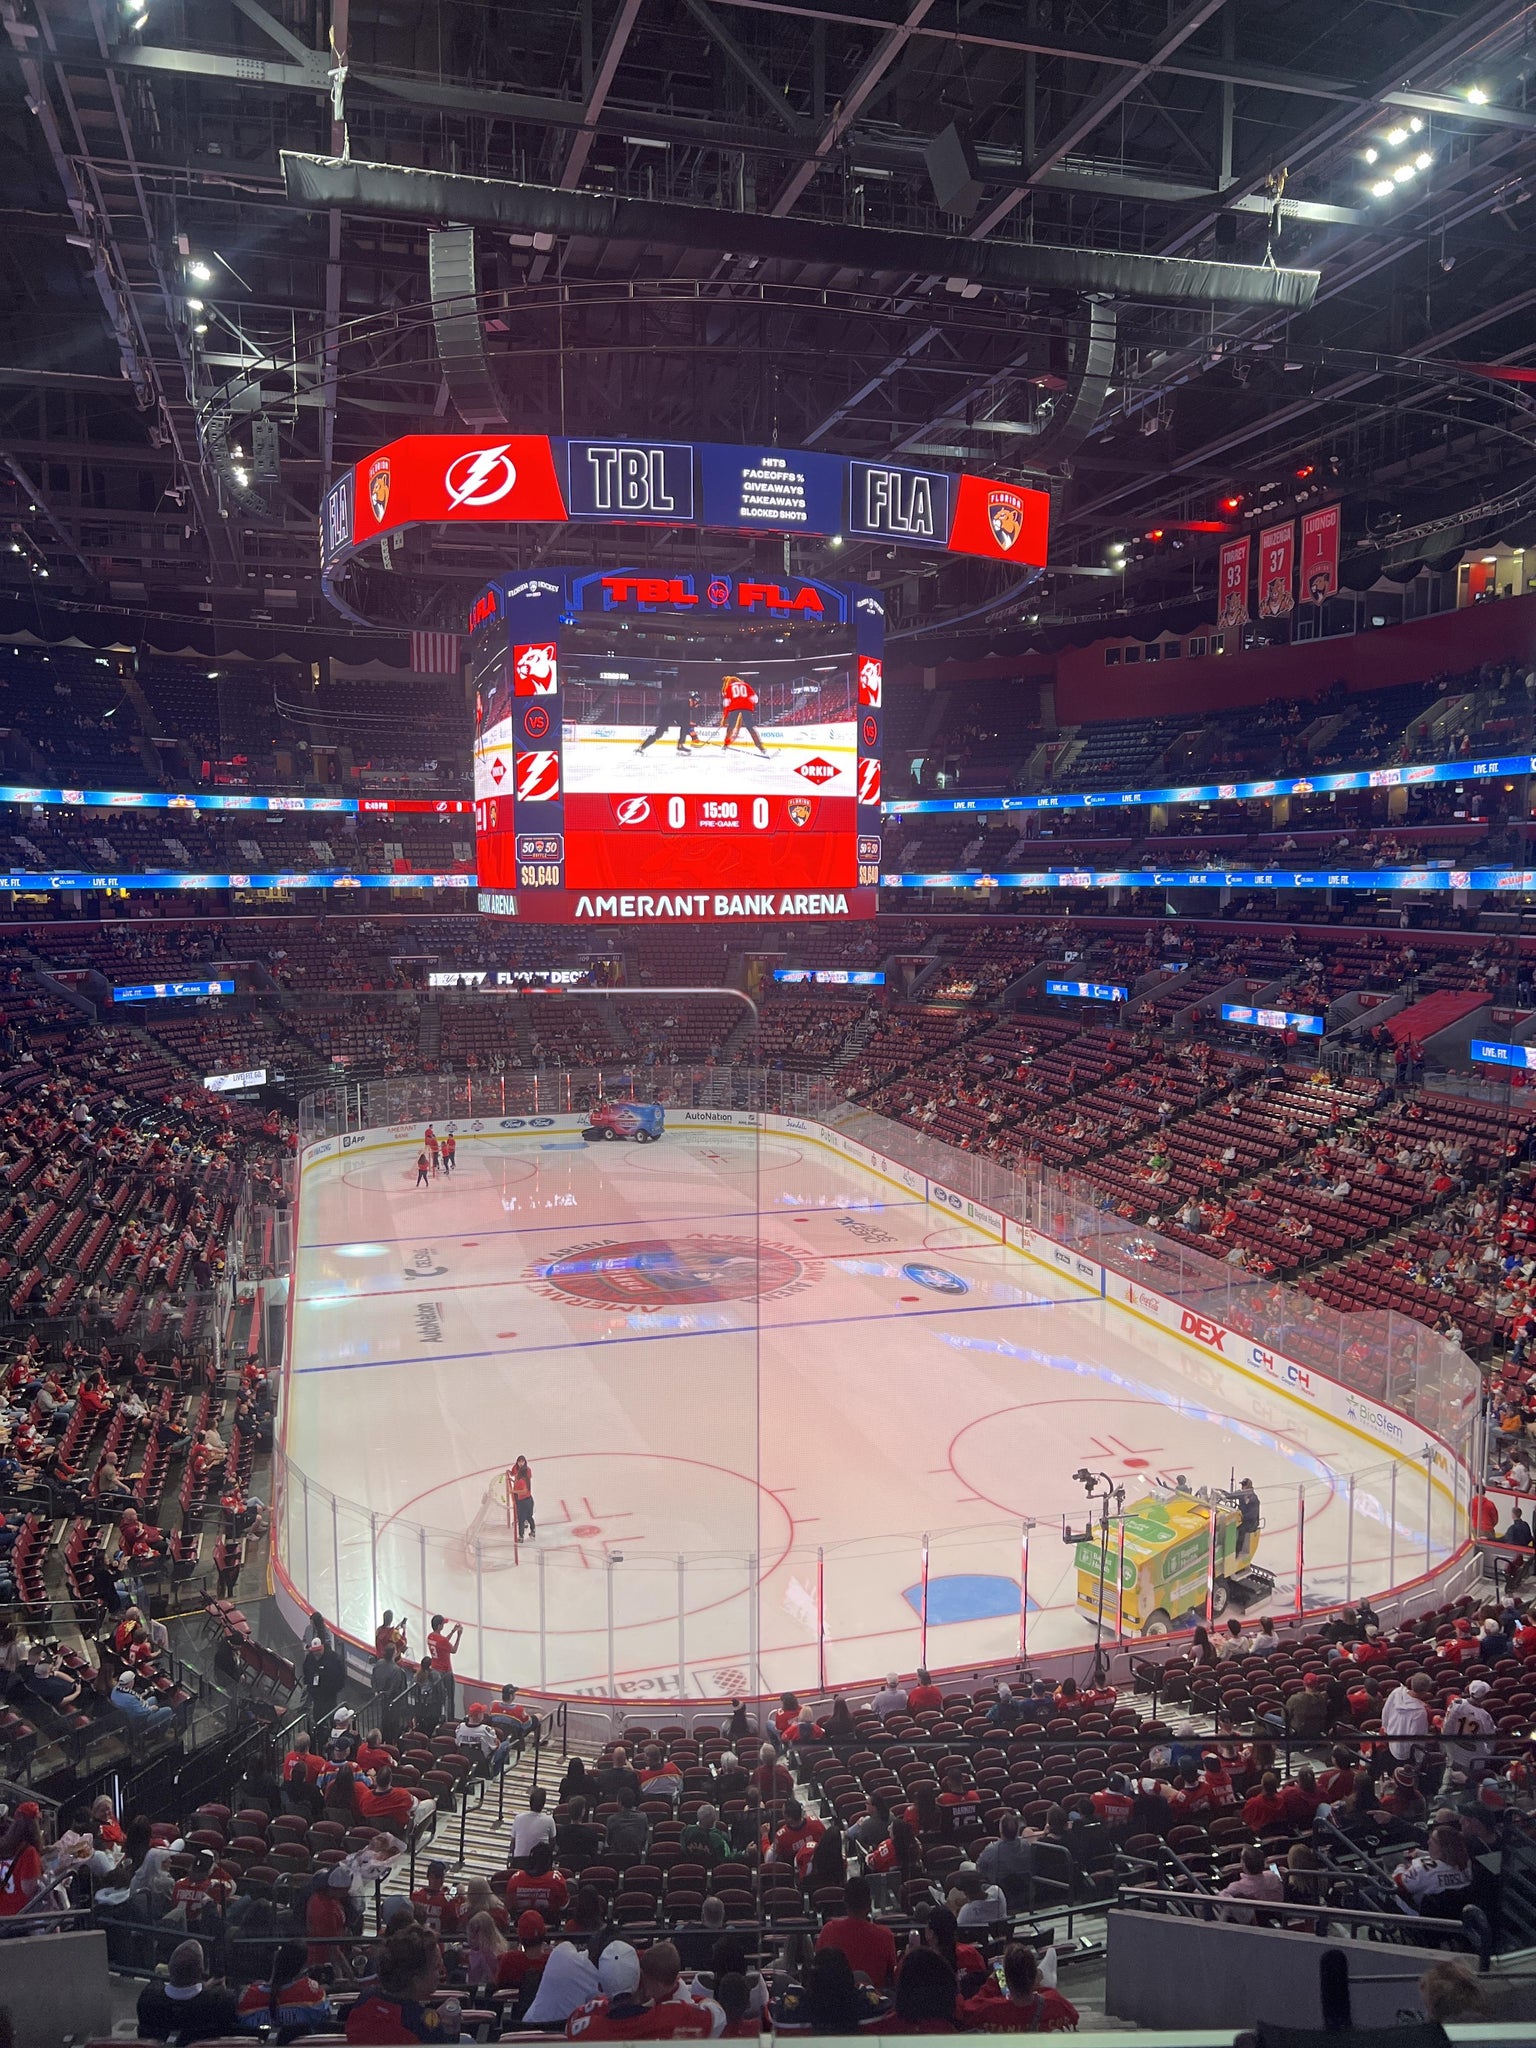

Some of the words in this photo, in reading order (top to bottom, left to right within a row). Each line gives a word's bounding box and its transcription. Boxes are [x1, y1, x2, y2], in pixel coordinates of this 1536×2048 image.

[762, 457, 786, 468] HITS
[588, 448, 674, 510] TBL
[743, 469, 796, 482] FACEOFFS
[796, 474, 805, 482] %
[744, 482, 804, 495] GIVEAWAYS
[742, 494, 806, 508] TAKEAWAYS
[867, 469, 934, 534] FLA
[990, 493, 1021, 508] FLORIDA
[329, 484, 348, 550] FLA
[740, 507, 778, 519] BLOCKED
[779, 509, 807, 521] SHOTS
[1305, 512, 1337, 535] LUONGO
[1223, 548, 1246, 564] TORREY
[1316, 534, 1324, 556] 1
[1269, 549, 1285, 572] 37
[1226, 564, 1241, 588] 93
[602, 578, 699, 604] TBL
[739, 583, 825, 611] FLA
[529, 717, 544, 728] VS
[800, 766, 834, 777] ORKIN
[668, 796, 686, 829] 0
[702, 802, 738, 818] 15:00
[753, 797, 769, 829] 0
[522, 842, 535, 853] 50
[545, 842, 557, 853] 50
[521, 865, 559, 887] $9,640
[492, 894, 515, 916] ARENA
[575, 894, 710, 917] AMERANT
[715, 894, 775, 916] BANK
[779, 893, 849, 915] ARENA
[497, 971, 549, 985] FLIGT
[685, 1112, 732, 1121] AutoNation
[351, 1136, 365, 1144] App
[387, 1125, 416, 1133] AMERANT
[552, 1238, 619, 1259] ARENA
[414, 1302, 443, 1343] AutoNation
[1180, 1310, 1227, 1352] DEX
[1252, 1348, 1273, 1370] CH
[1287, 1365, 1309, 1388] CH
[1360, 1405, 1403, 1440] BioStem
